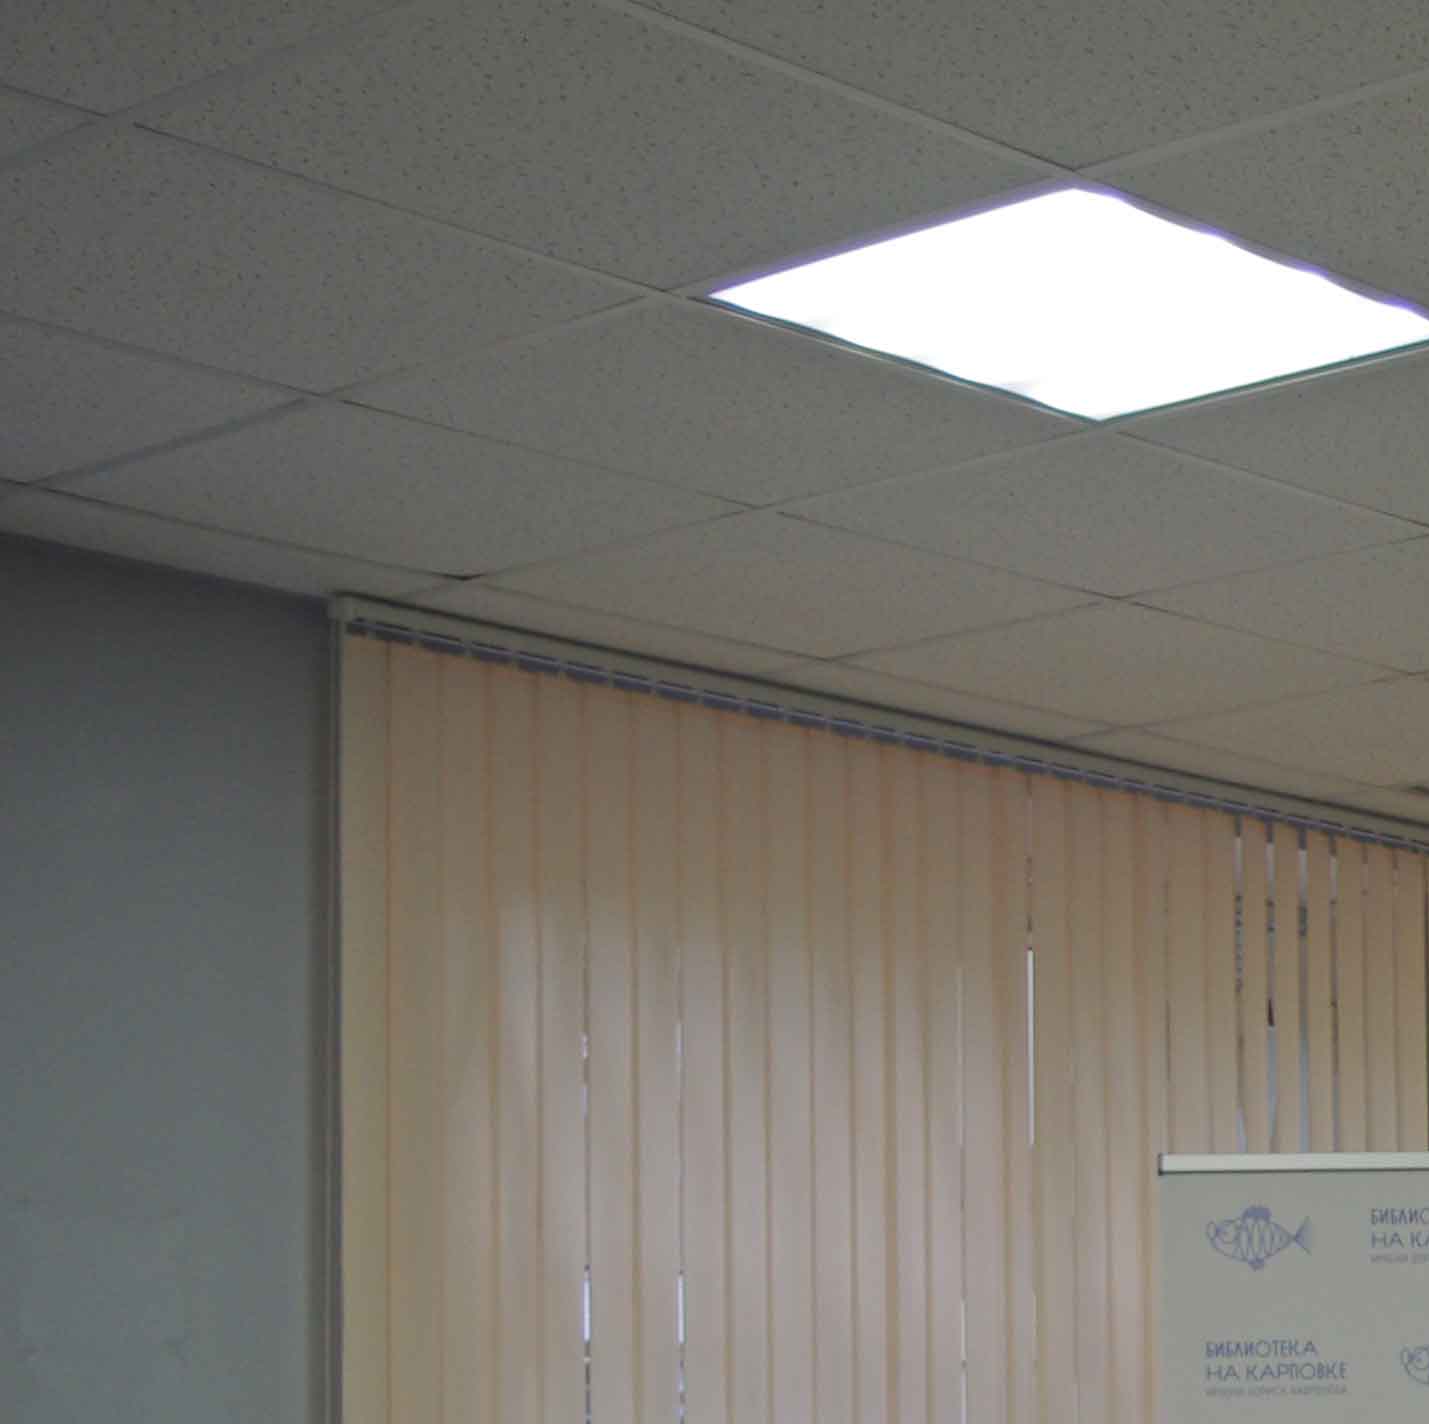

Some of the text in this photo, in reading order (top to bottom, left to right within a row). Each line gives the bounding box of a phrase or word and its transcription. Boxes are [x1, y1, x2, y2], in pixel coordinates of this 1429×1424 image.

[1371, 1231, 1404, 1248] НА
[1206, 1340, 1319, 1359] БИБЛИОТЕКА
[1206, 1362, 1348, 1381] НА КАРПОВКЕ
